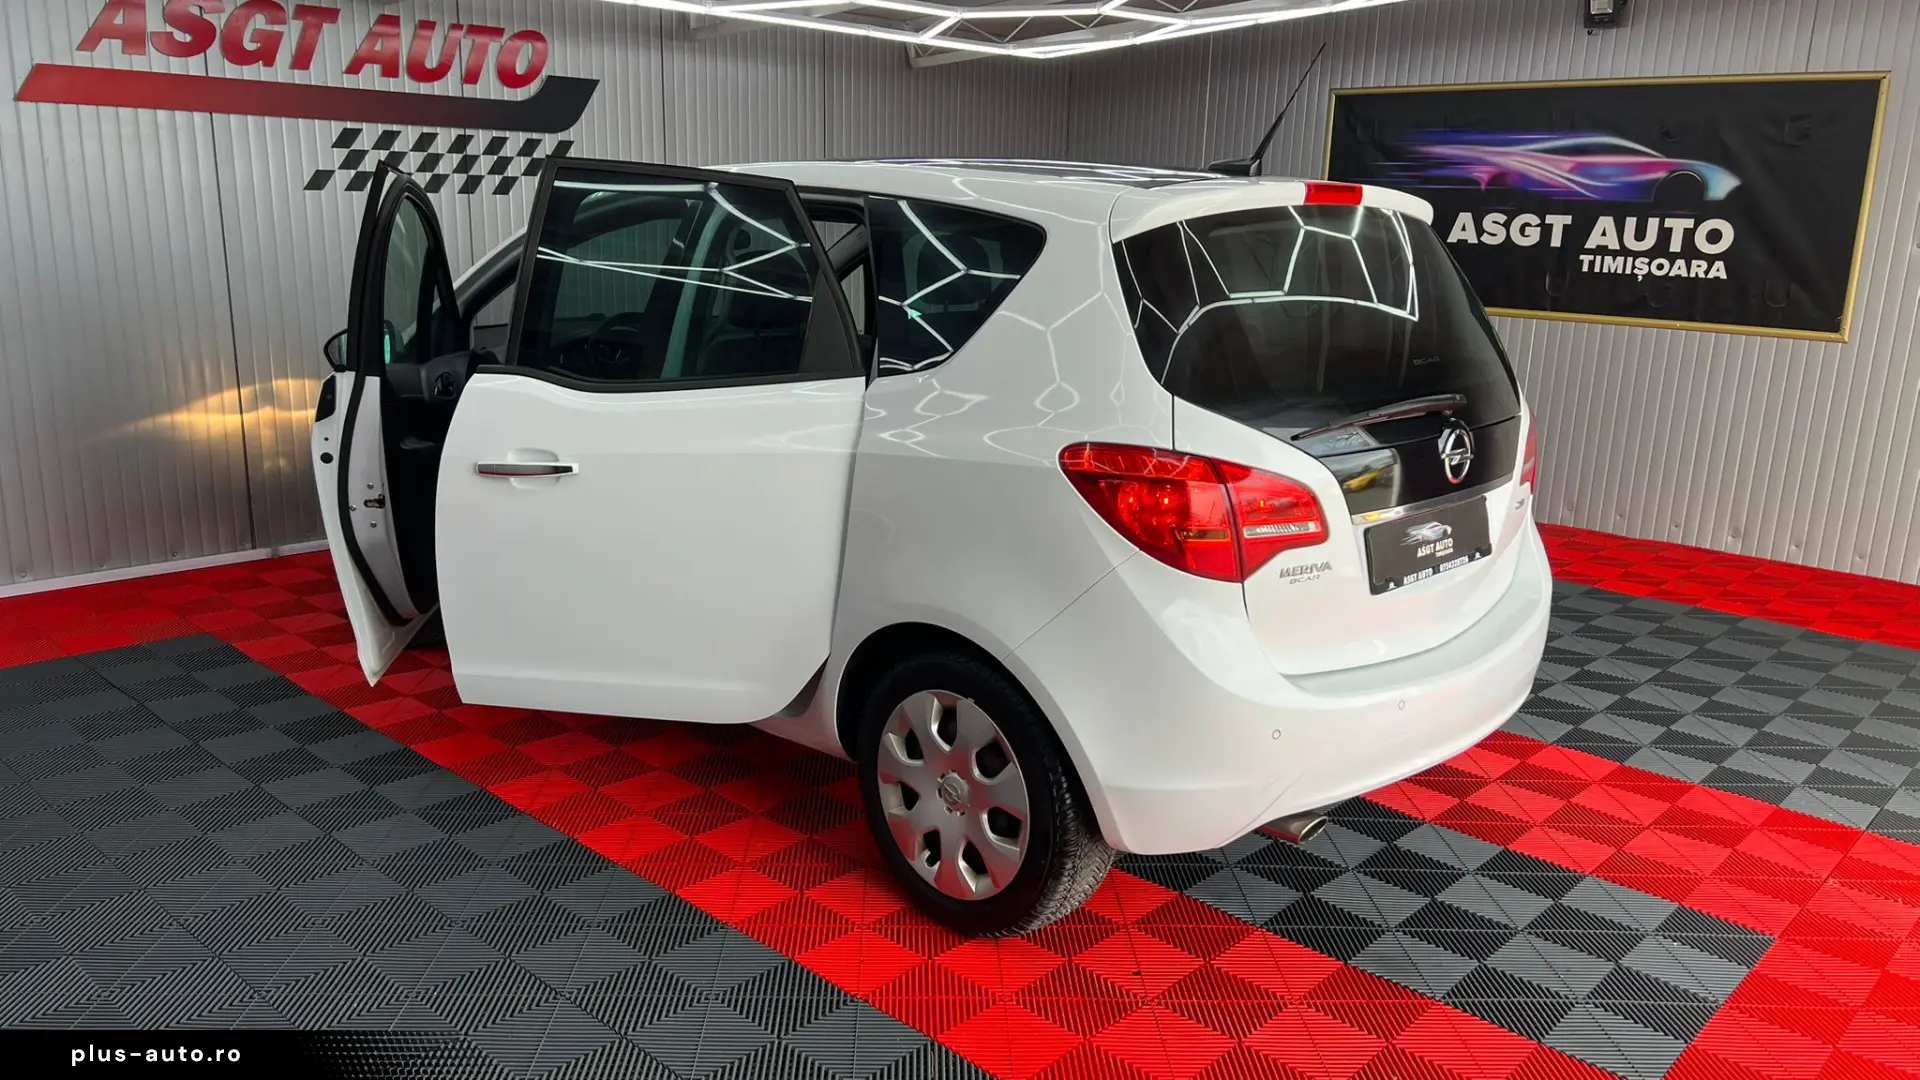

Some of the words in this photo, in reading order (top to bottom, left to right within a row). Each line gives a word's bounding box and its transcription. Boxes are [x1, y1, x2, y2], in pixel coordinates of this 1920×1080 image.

[75, 0, 341, 70] ASGT
[345, 13, 549, 89] AUTO
[1446, 212, 1573, 248] ASGT
[1585, 216, 1735, 255] AUTO
[1579, 254, 1728, 282] TIMIȘOARA
[1417, 543, 1435, 558] ASGT
[1435, 537, 1454, 552] AUTO
[1279, 560, 1333, 579] MERIVA
[1403, 572, 1418, 586] ASGT
[1418, 567, 1434, 580] AUTO
